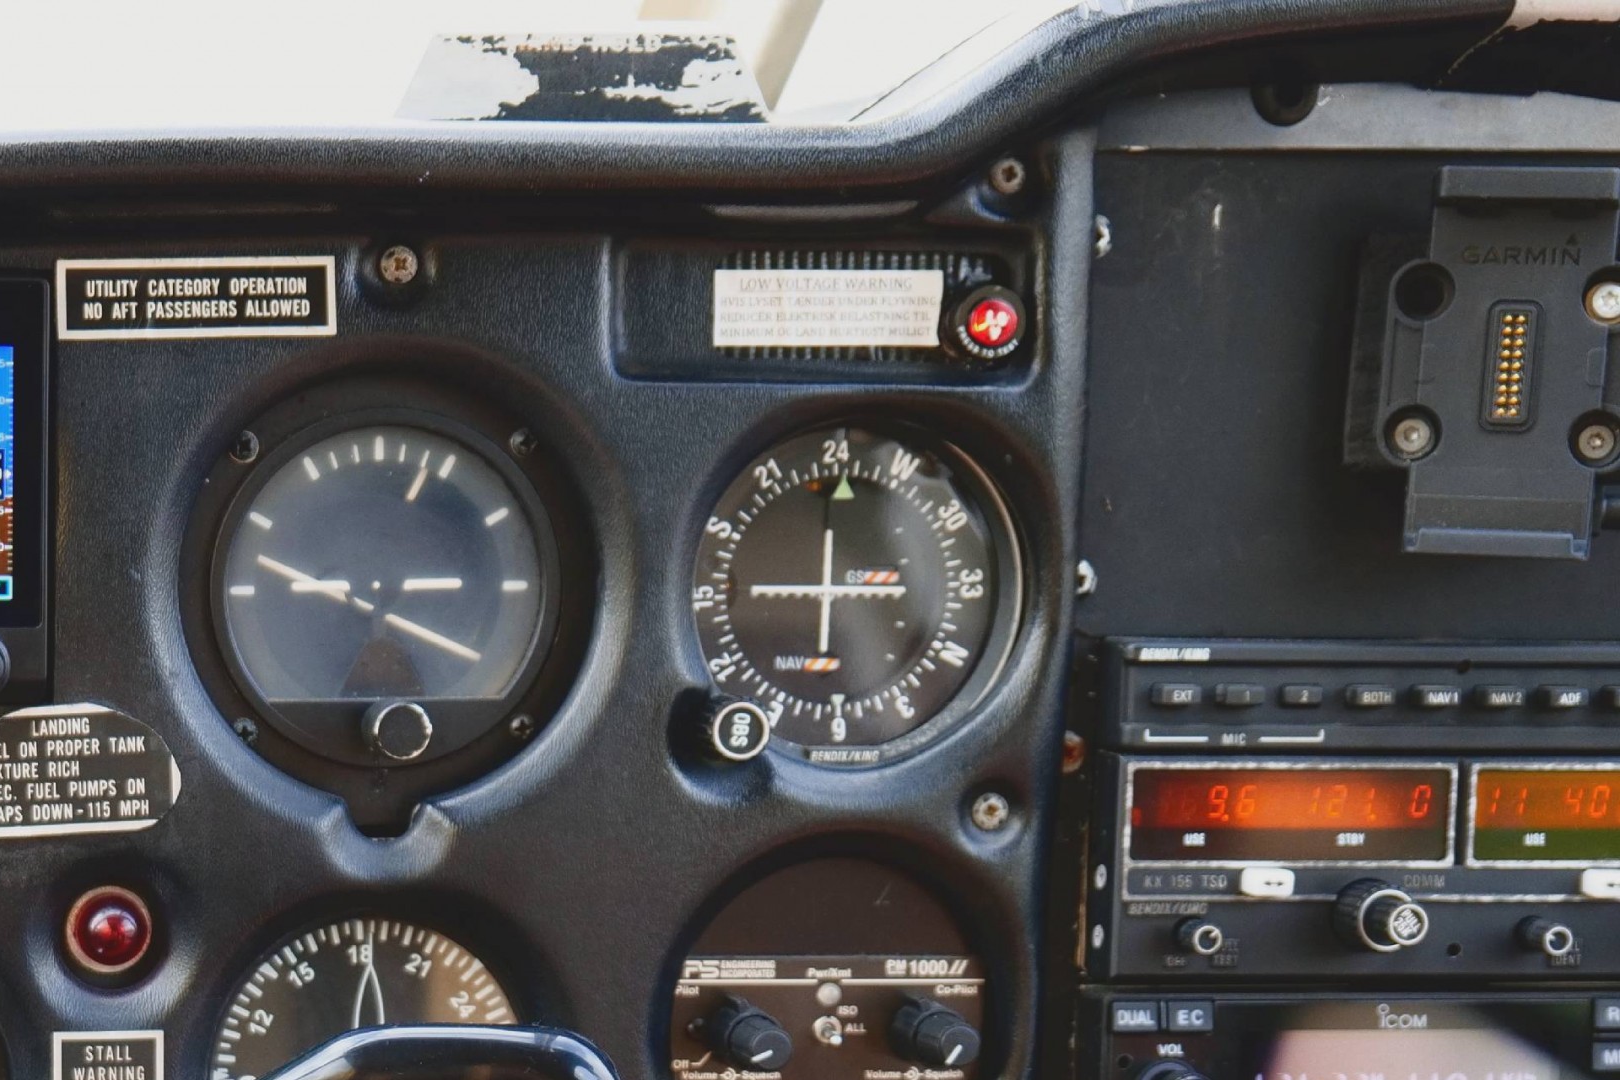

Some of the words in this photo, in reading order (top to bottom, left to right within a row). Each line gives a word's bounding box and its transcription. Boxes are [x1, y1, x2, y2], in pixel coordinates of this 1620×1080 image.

[1462, 245, 1581, 267] GARMIN
[86, 279, 138, 297] UTILITY
[148, 278, 220, 297] CATEGORY
[230, 277, 307, 295] OPERATION
[739, 278, 771, 290] LOW
[776, 278, 839, 290] VOLTAGE
[843, 277, 913, 290] WARNING
[83, 301, 103, 320] NO
[112, 302, 138, 320] AFT
[147, 301, 237, 319] PASSENGERS
[245, 299, 310, 317] ALLOWED
[822, 441, 849, 462] 24
[776, 658, 804, 669] NAV
[1174, 690, 1192, 701] EXT
[31, 718, 90, 737] LANDING
[731, 714, 749, 746] OBS
[20, 741, 39, 758] ON
[47, 739, 101, 758] PROPER
[109, 737, 145, 755] TANK
[1222, 733, 1246, 745] MIC
[48, 760, 80, 779] RICH
[27, 782, 61, 799] FUEL
[70, 780, 117, 798] PUMPS
[127, 779, 145, 795] ON
[120, 799, 150, 817] MPH
[405, 953, 433, 977] 21
[1117, 1009, 1153, 1024] DUAL
[85, 1046, 133, 1062] STALL
[1158, 1044, 1183, 1056] VOL
